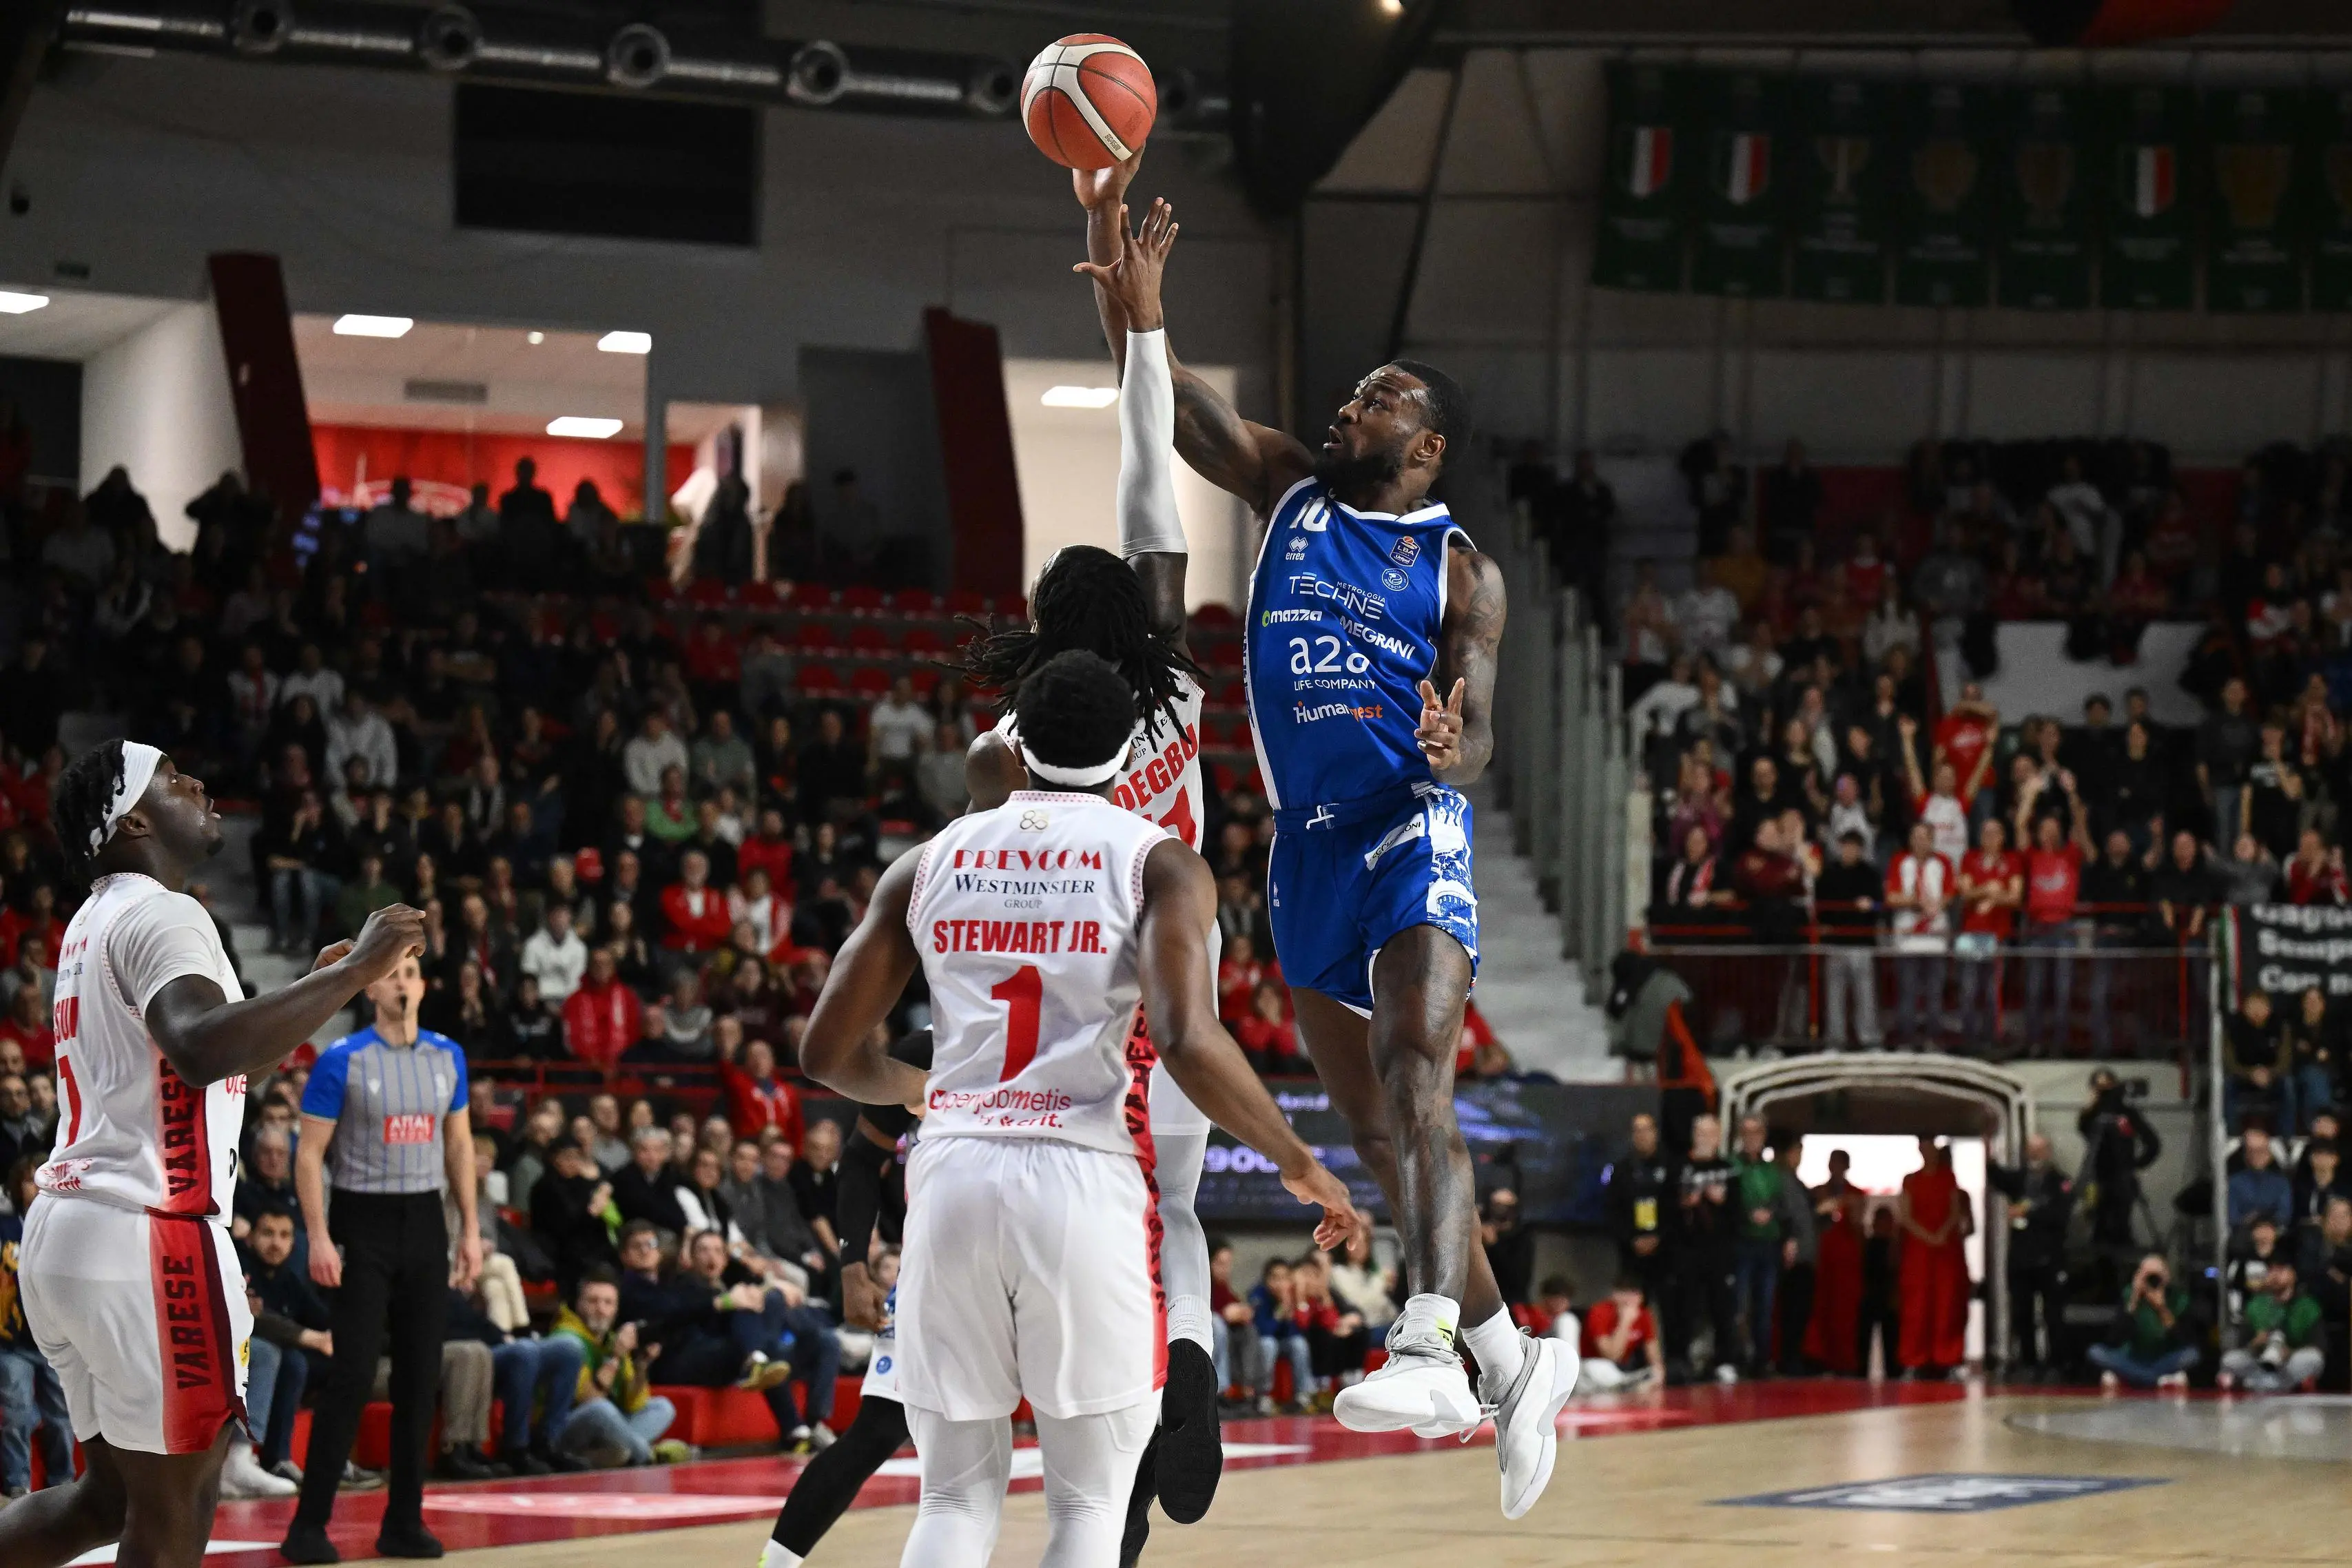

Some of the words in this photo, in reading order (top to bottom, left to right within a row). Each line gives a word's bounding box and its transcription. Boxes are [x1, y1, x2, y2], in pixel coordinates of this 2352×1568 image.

[1395, 554, 1410, 564] Unipol
[1397, 545, 1414, 556] LBA
[1337, 581, 1385, 603] METROLOGIA
[1294, 679, 1313, 691] LIFE
[1314, 679, 1376, 689] COMPANY
[955, 874, 1095, 895] WESTMINSTER
[1004, 899, 1043, 909] GROUP
[933, 920, 1064, 954] STEWART
[1067, 920, 1107, 954] JR.
[991, 964, 1043, 1083] 1
[163, 1255, 212, 1390] VARESE
